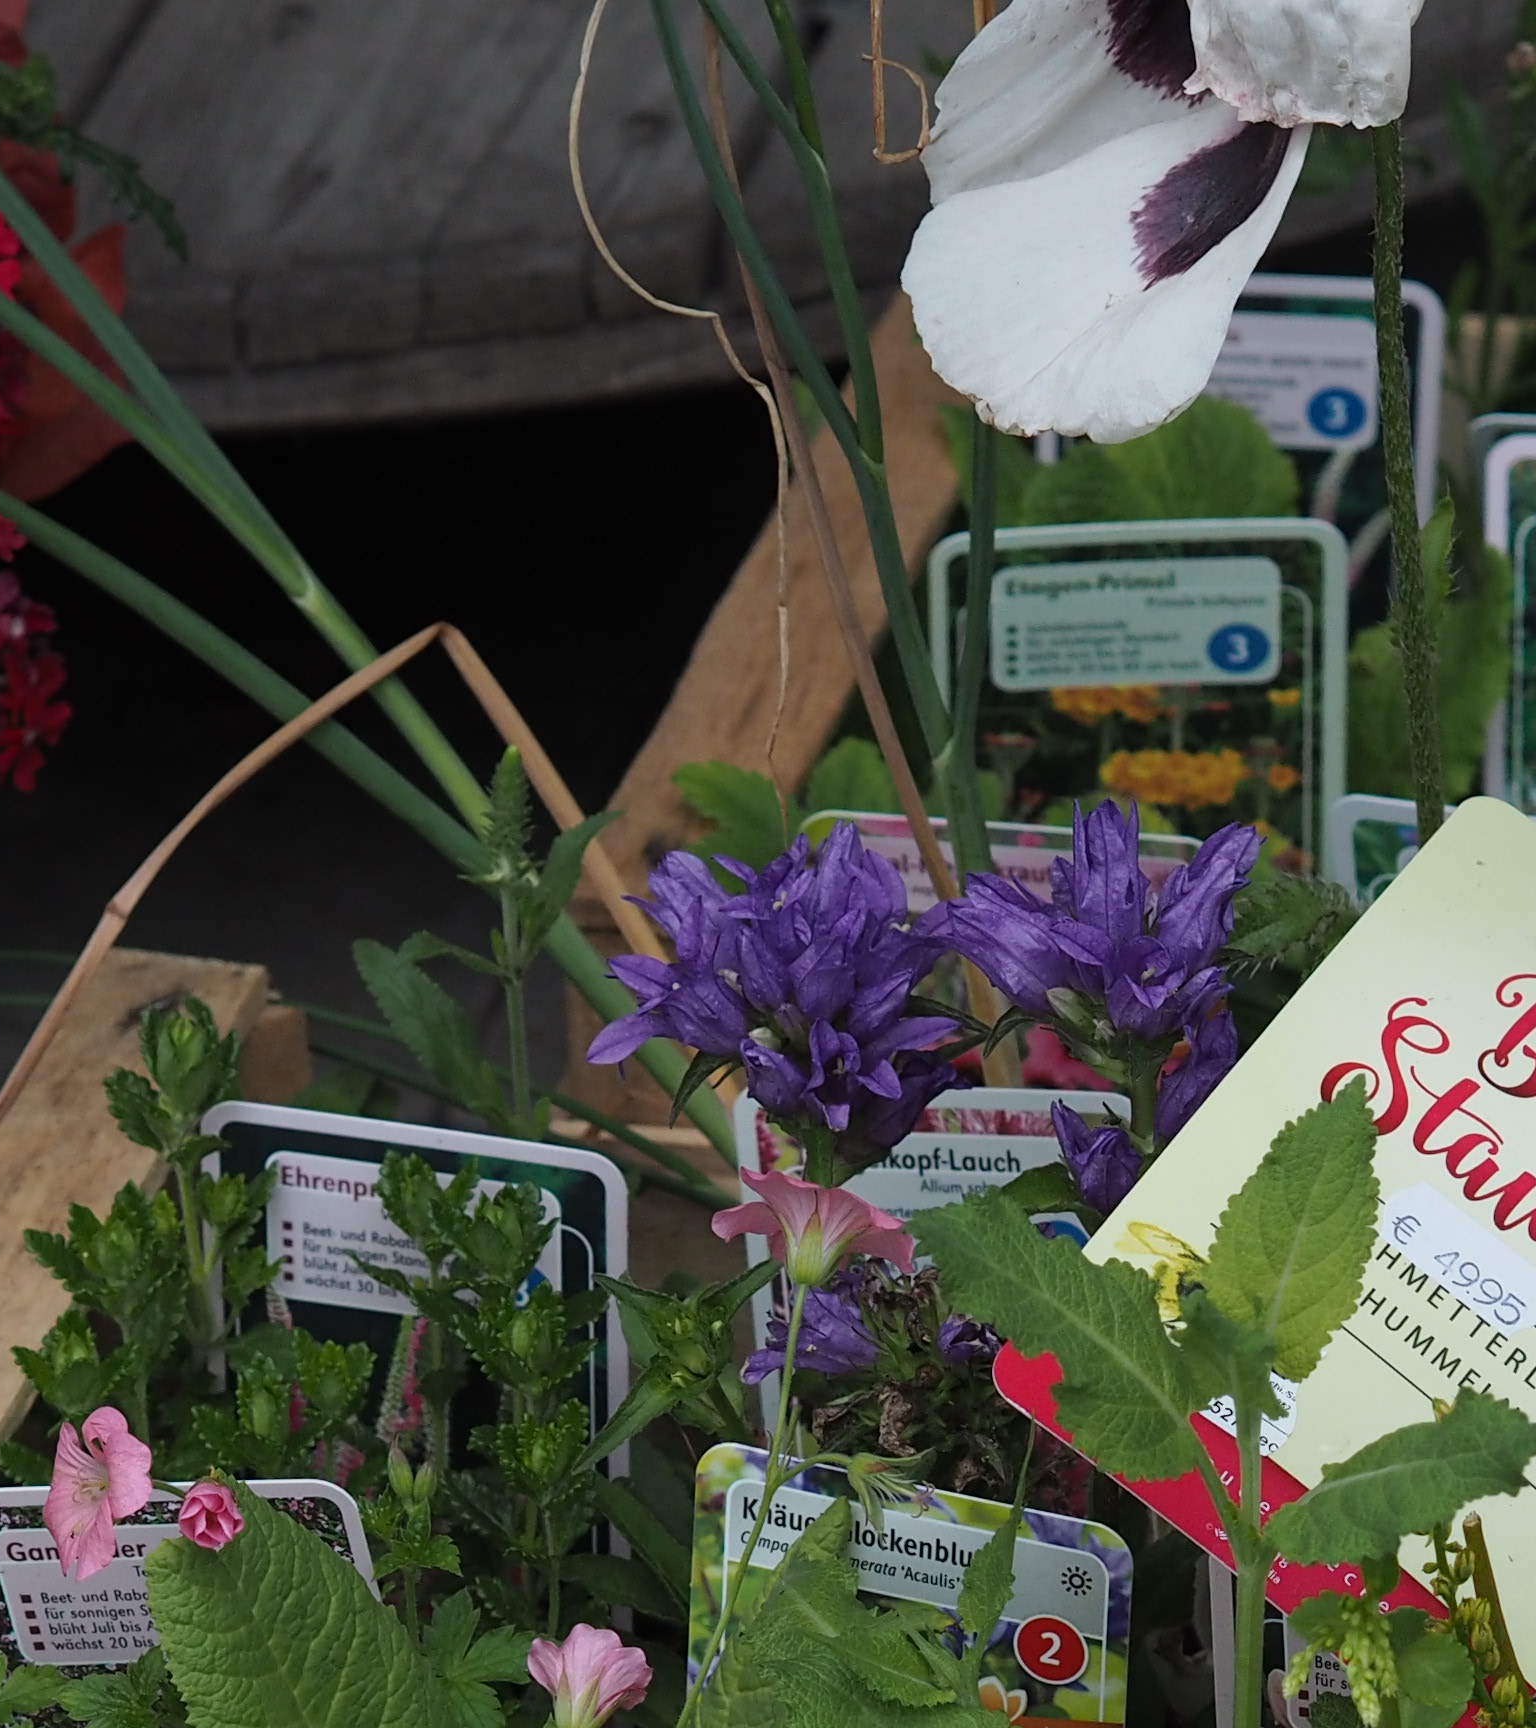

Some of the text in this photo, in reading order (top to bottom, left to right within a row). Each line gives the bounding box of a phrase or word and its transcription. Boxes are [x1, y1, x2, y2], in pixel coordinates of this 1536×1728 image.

[1323, 394, 1349, 431] 3
[1225, 633, 1251, 664] 3
[920, 1179, 963, 1193] Allium
[340, 1227, 366, 1243] und
[1390, 1214, 1422, 1246] €
[303, 1238, 324, 1252] für
[303, 1254, 339, 1273] blüht
[304, 1272, 353, 1291] wächst
[356, 1281, 374, 1295] 30
[39, 1591, 77, 1605] Beet-
[81, 1590, 109, 1603] und
[44, 1607, 65, 1620] für
[70, 1606, 136, 1621] sonnigen
[48, 1622, 87, 1636] blüht
[91, 1621, 116, 1635] Juli
[119, 1620, 142, 1634] bis
[52, 1635, 154, 1651] wächst 20 bis
[1039, 1630, 1061, 1667] 2
[1314, 1672, 1336, 1688] für
